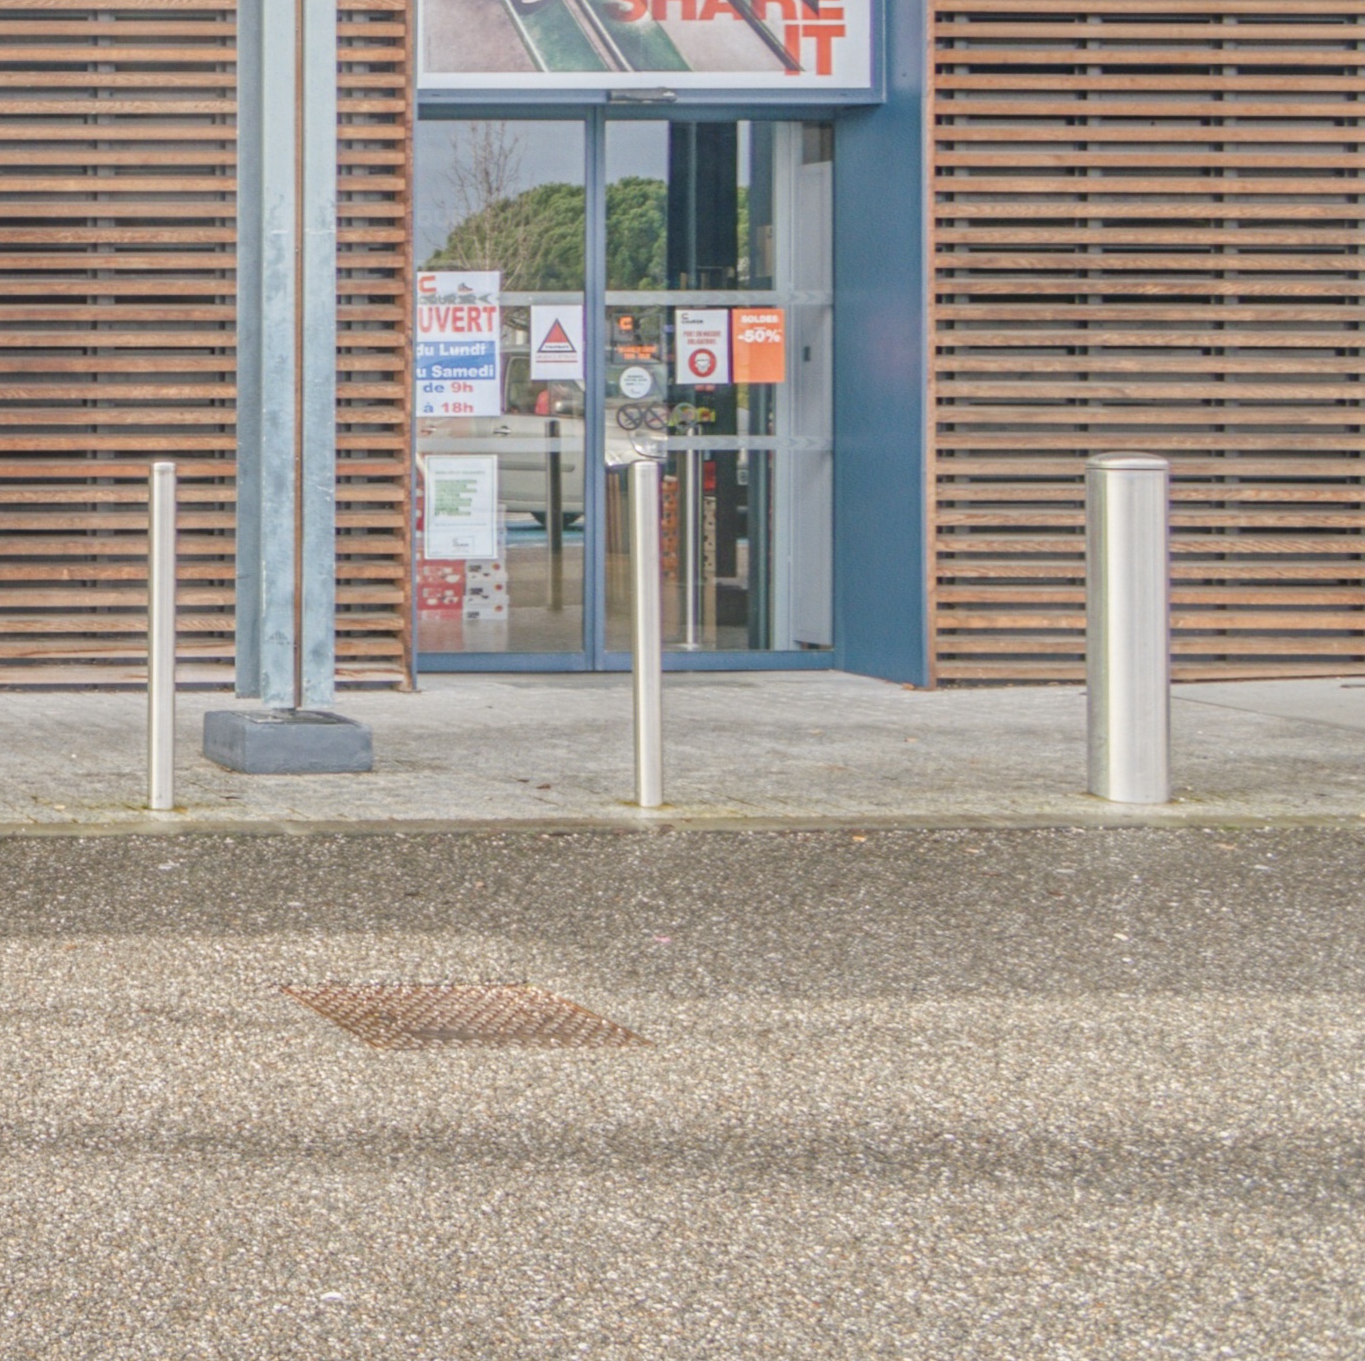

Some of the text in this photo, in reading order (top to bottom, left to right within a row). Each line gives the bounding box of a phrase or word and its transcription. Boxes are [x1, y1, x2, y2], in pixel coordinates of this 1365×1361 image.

[784, 25, 846, 76] IT
[741, 315, 778, 324] SOLDES
[737, 329, 780, 343] -50%
[439, 343, 487, 356] Lundi
[432, 364, 494, 378] Samedi
[423, 382, 474, 394] de 9h
[423, 401, 474, 414] à 18h
